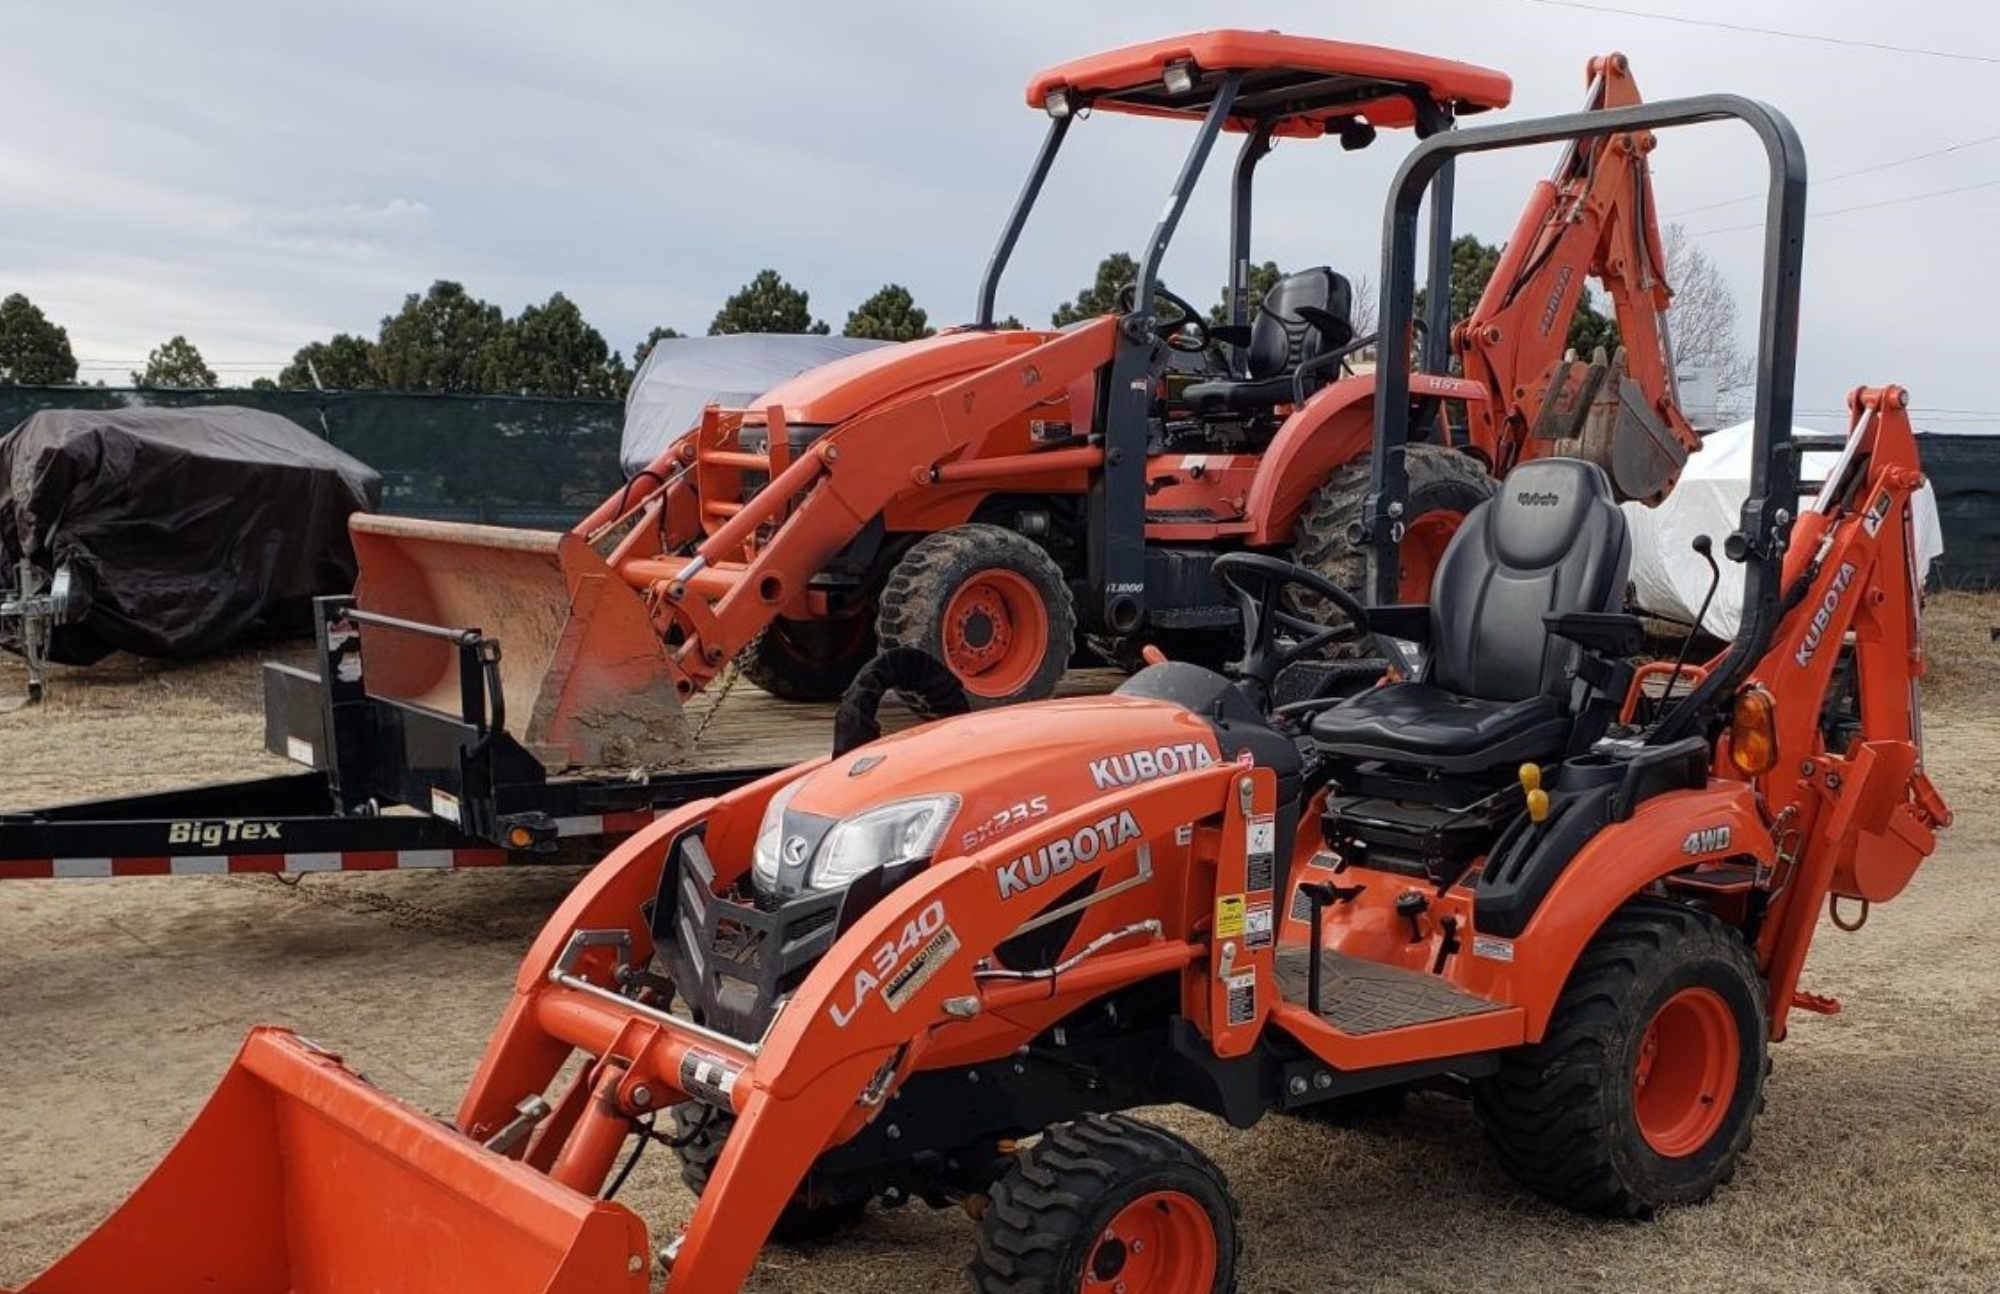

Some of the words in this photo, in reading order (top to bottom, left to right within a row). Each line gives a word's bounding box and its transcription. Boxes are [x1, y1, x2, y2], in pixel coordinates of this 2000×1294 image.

[1430, 379, 1462, 391] HST
[1795, 562, 1857, 667] KUBOTA
[1089, 743, 1213, 790] KUBOTA
[168, 819, 283, 848] BigTex
[995, 809, 1142, 900] KUBOTA
[1683, 827, 1731, 855] 4WD
[829, 900, 945, 1028] LA340
